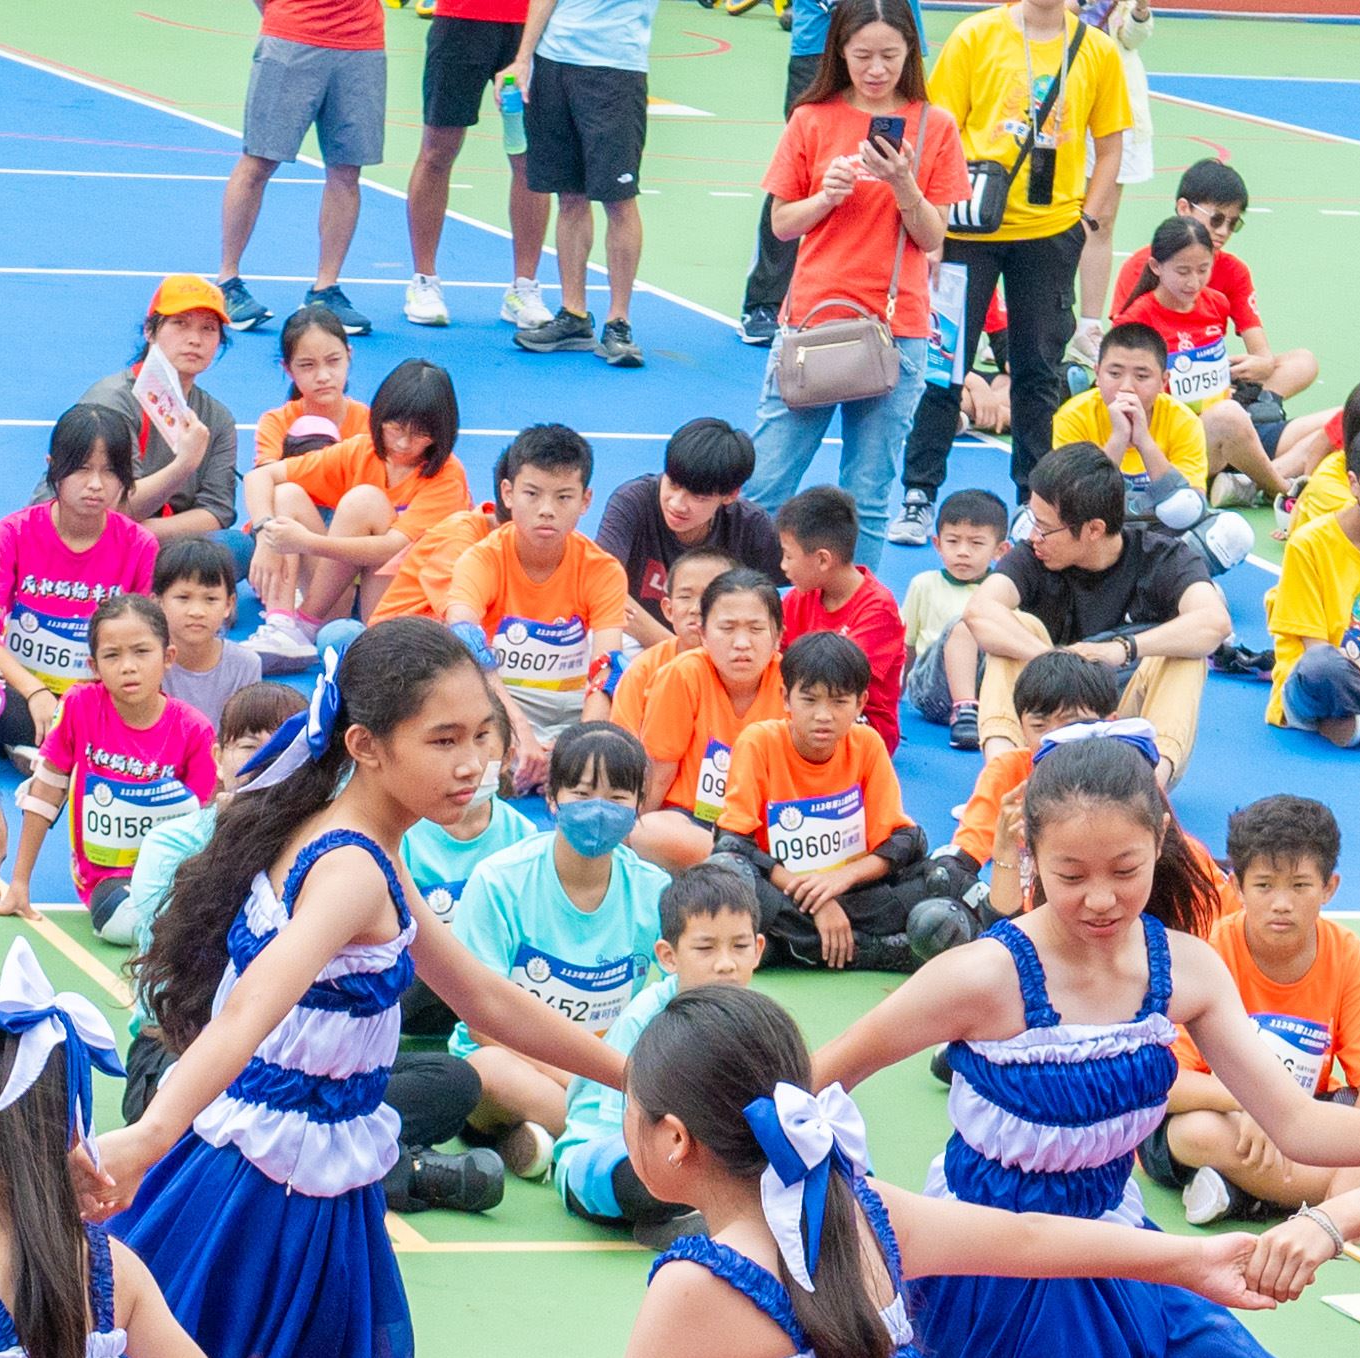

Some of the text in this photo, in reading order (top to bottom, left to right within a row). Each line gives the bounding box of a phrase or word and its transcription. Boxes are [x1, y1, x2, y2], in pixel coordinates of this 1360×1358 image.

[1175, 369, 1218, 396] 10759
[650, 572, 669, 593] L
[10, 632, 71, 668] 09156
[702, 773, 726, 798] 09
[87, 810, 154, 839] 09158
[775, 831, 841, 862] 09609
